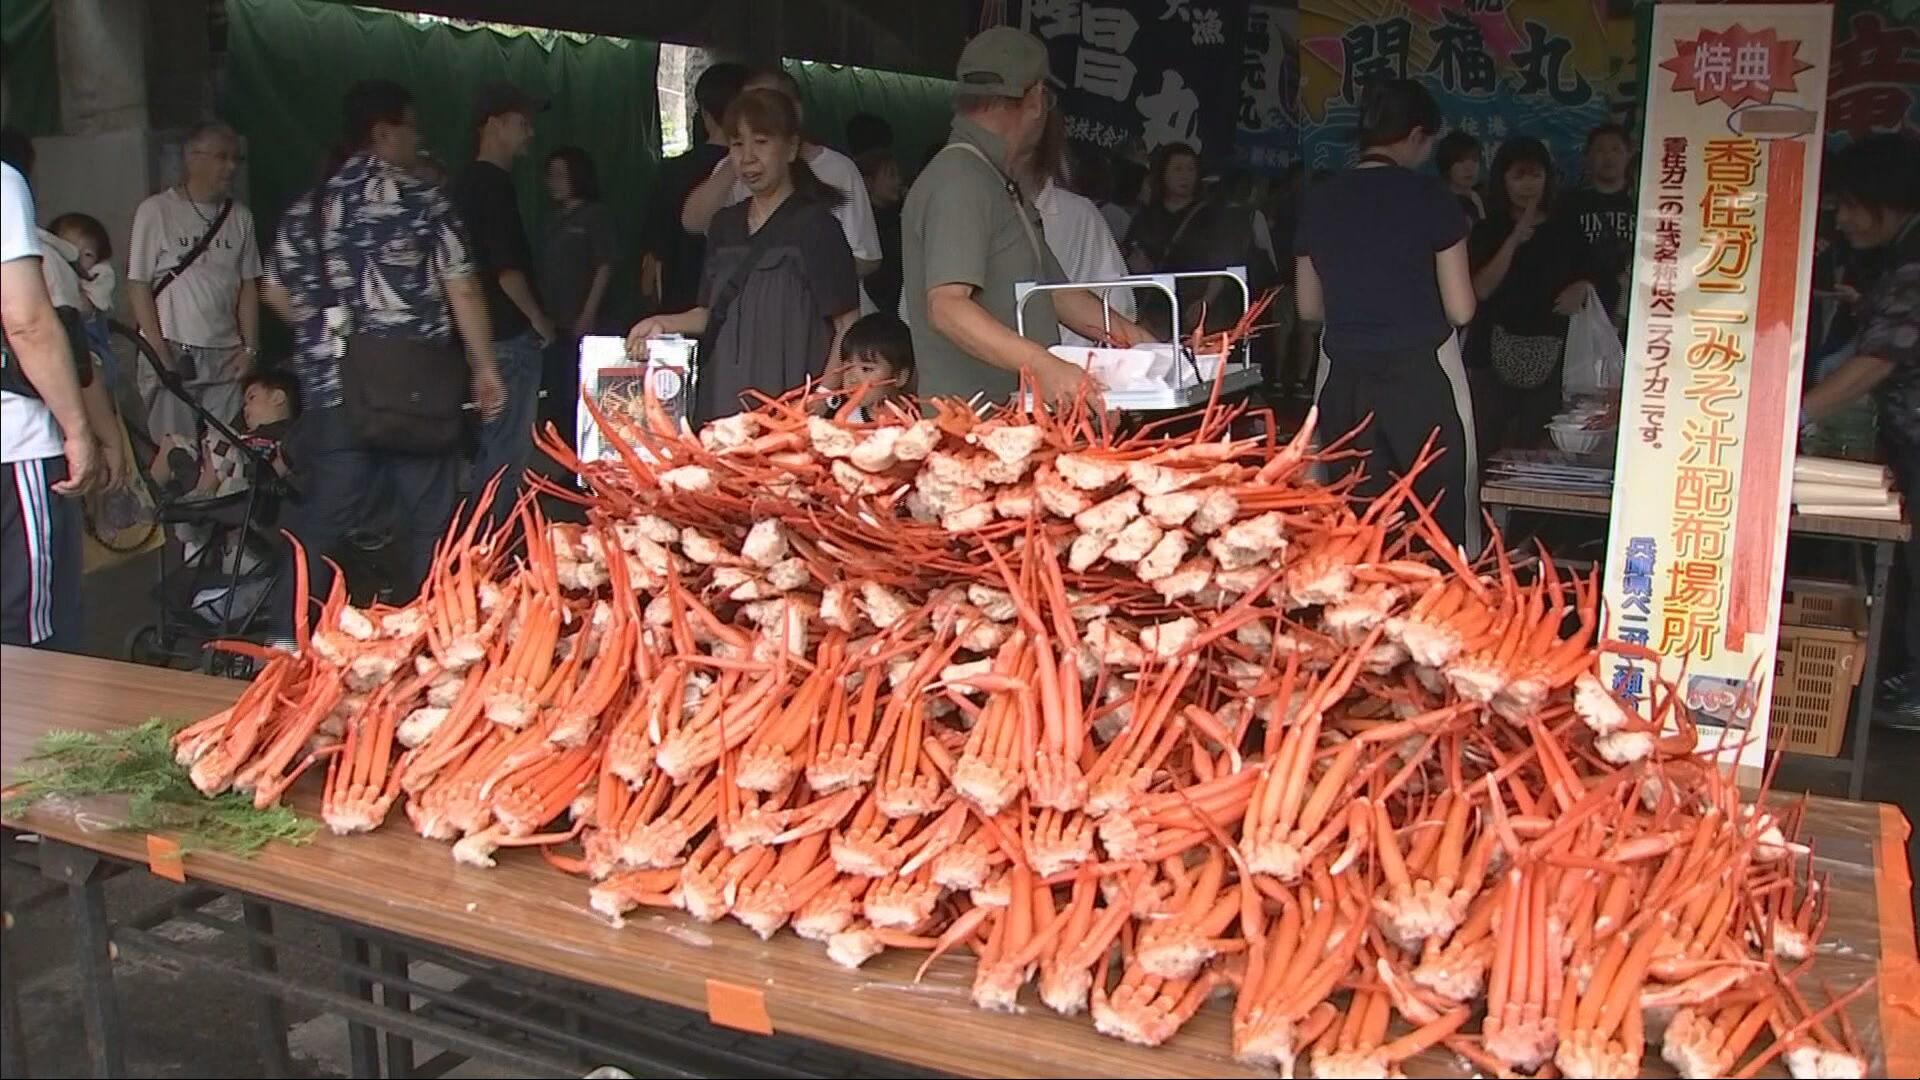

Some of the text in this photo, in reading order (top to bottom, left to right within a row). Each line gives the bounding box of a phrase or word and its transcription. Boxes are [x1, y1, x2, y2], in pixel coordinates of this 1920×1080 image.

[1693, 43, 1771, 92] 特典
[1658, 136, 1760, 661] 香住ガニみそ汁配布場所
